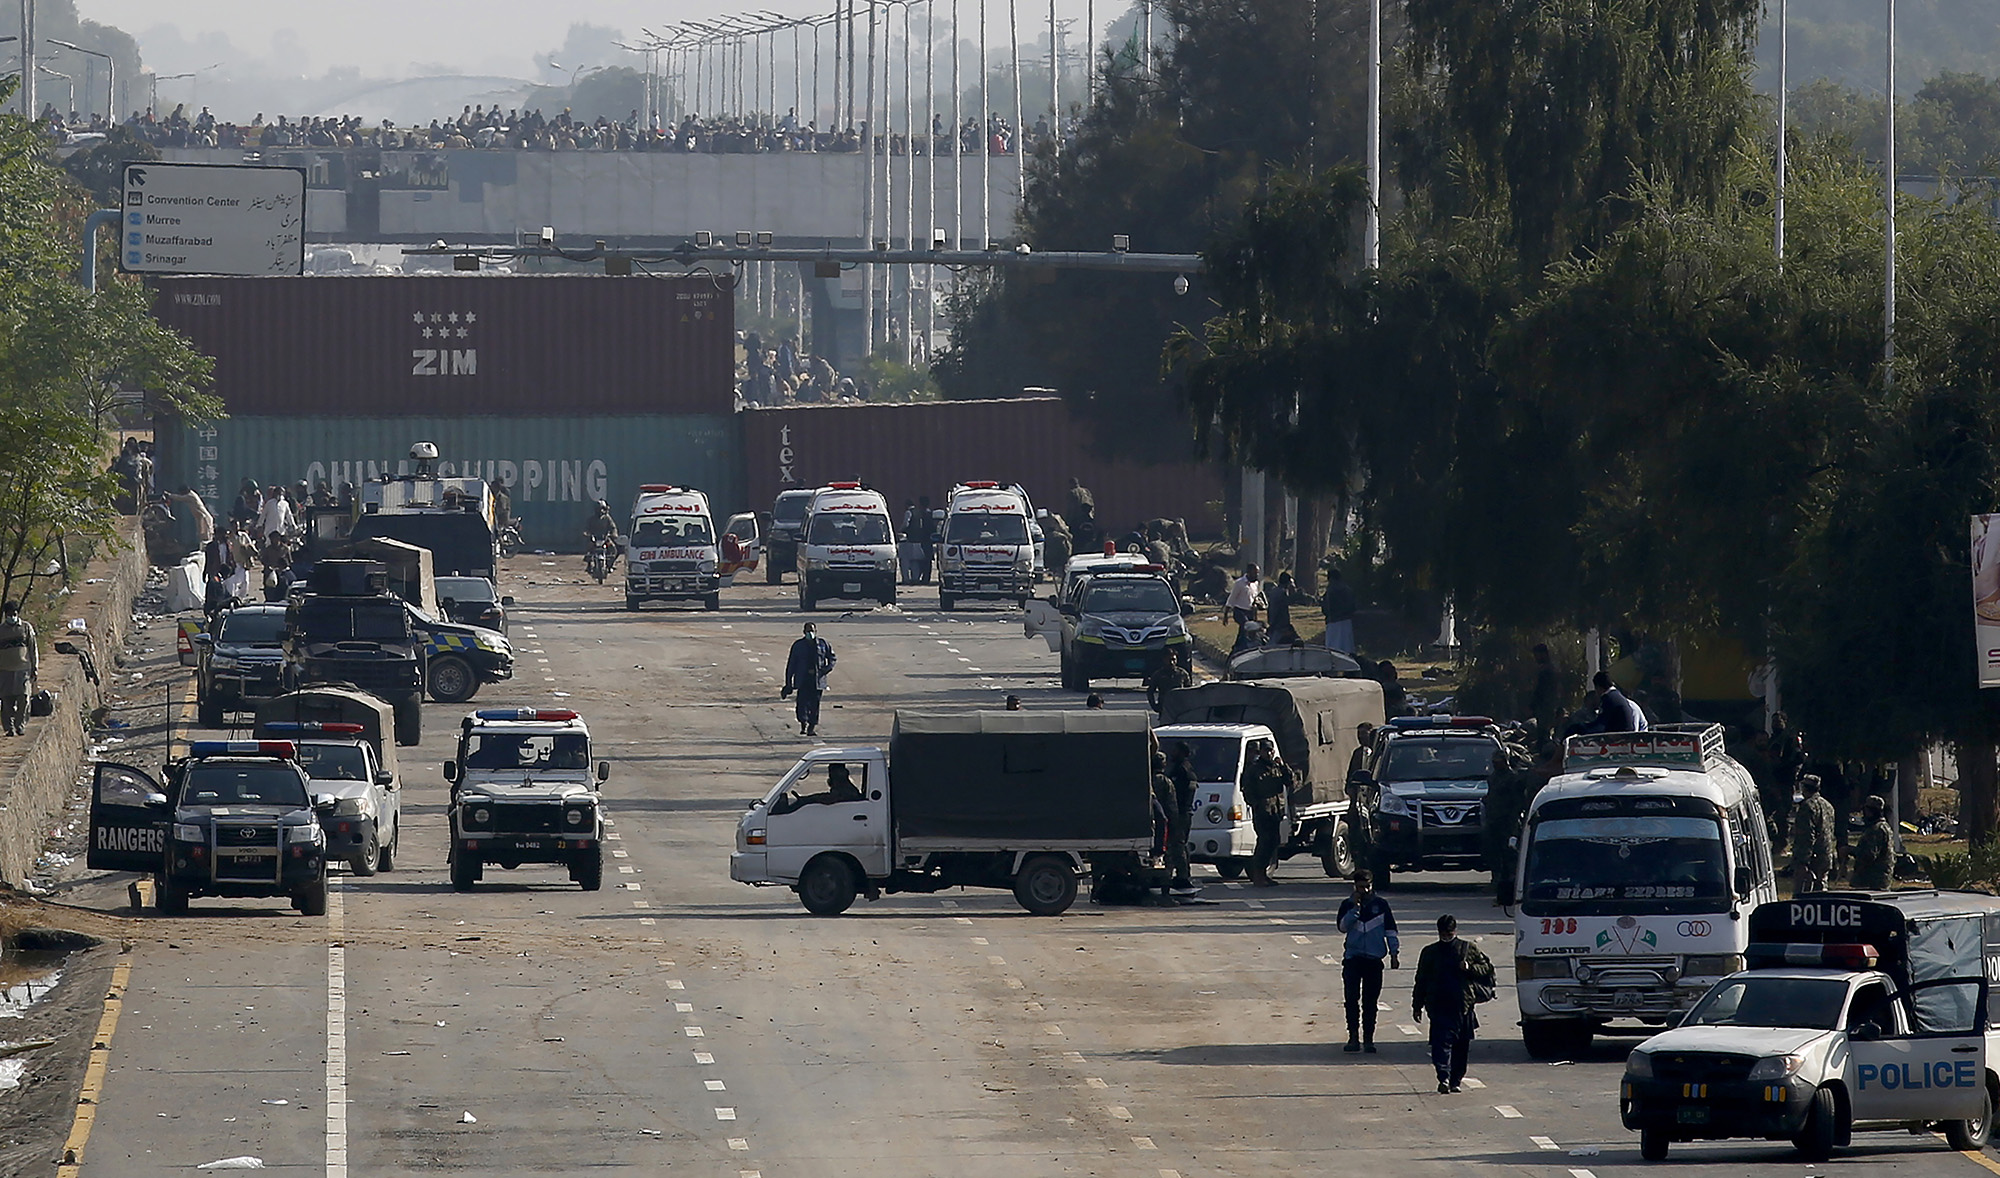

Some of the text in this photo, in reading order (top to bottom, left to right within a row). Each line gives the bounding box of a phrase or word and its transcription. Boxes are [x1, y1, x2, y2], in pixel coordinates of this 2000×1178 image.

[147, 195, 240, 207] Convention Center
[146, 214, 181, 225] Murree
[146, 234, 213, 246] Muzaffarabad
[145, 253, 187, 266] Srinagar
[413, 349, 477, 376] ZIM
[779, 424, 795, 483] tex
[198, 428, 219, 517] 中国海运
[640, 549, 705, 560] EDHI AMBULANCE
[97, 826, 165, 853] RANGERS
[1623, 886, 1695, 898] EXPRESS
[1790, 903, 1862, 927] POLICE
[1534, 946, 1591, 955] COASTER
[1857, 1060, 1976, 1091] POLICE
